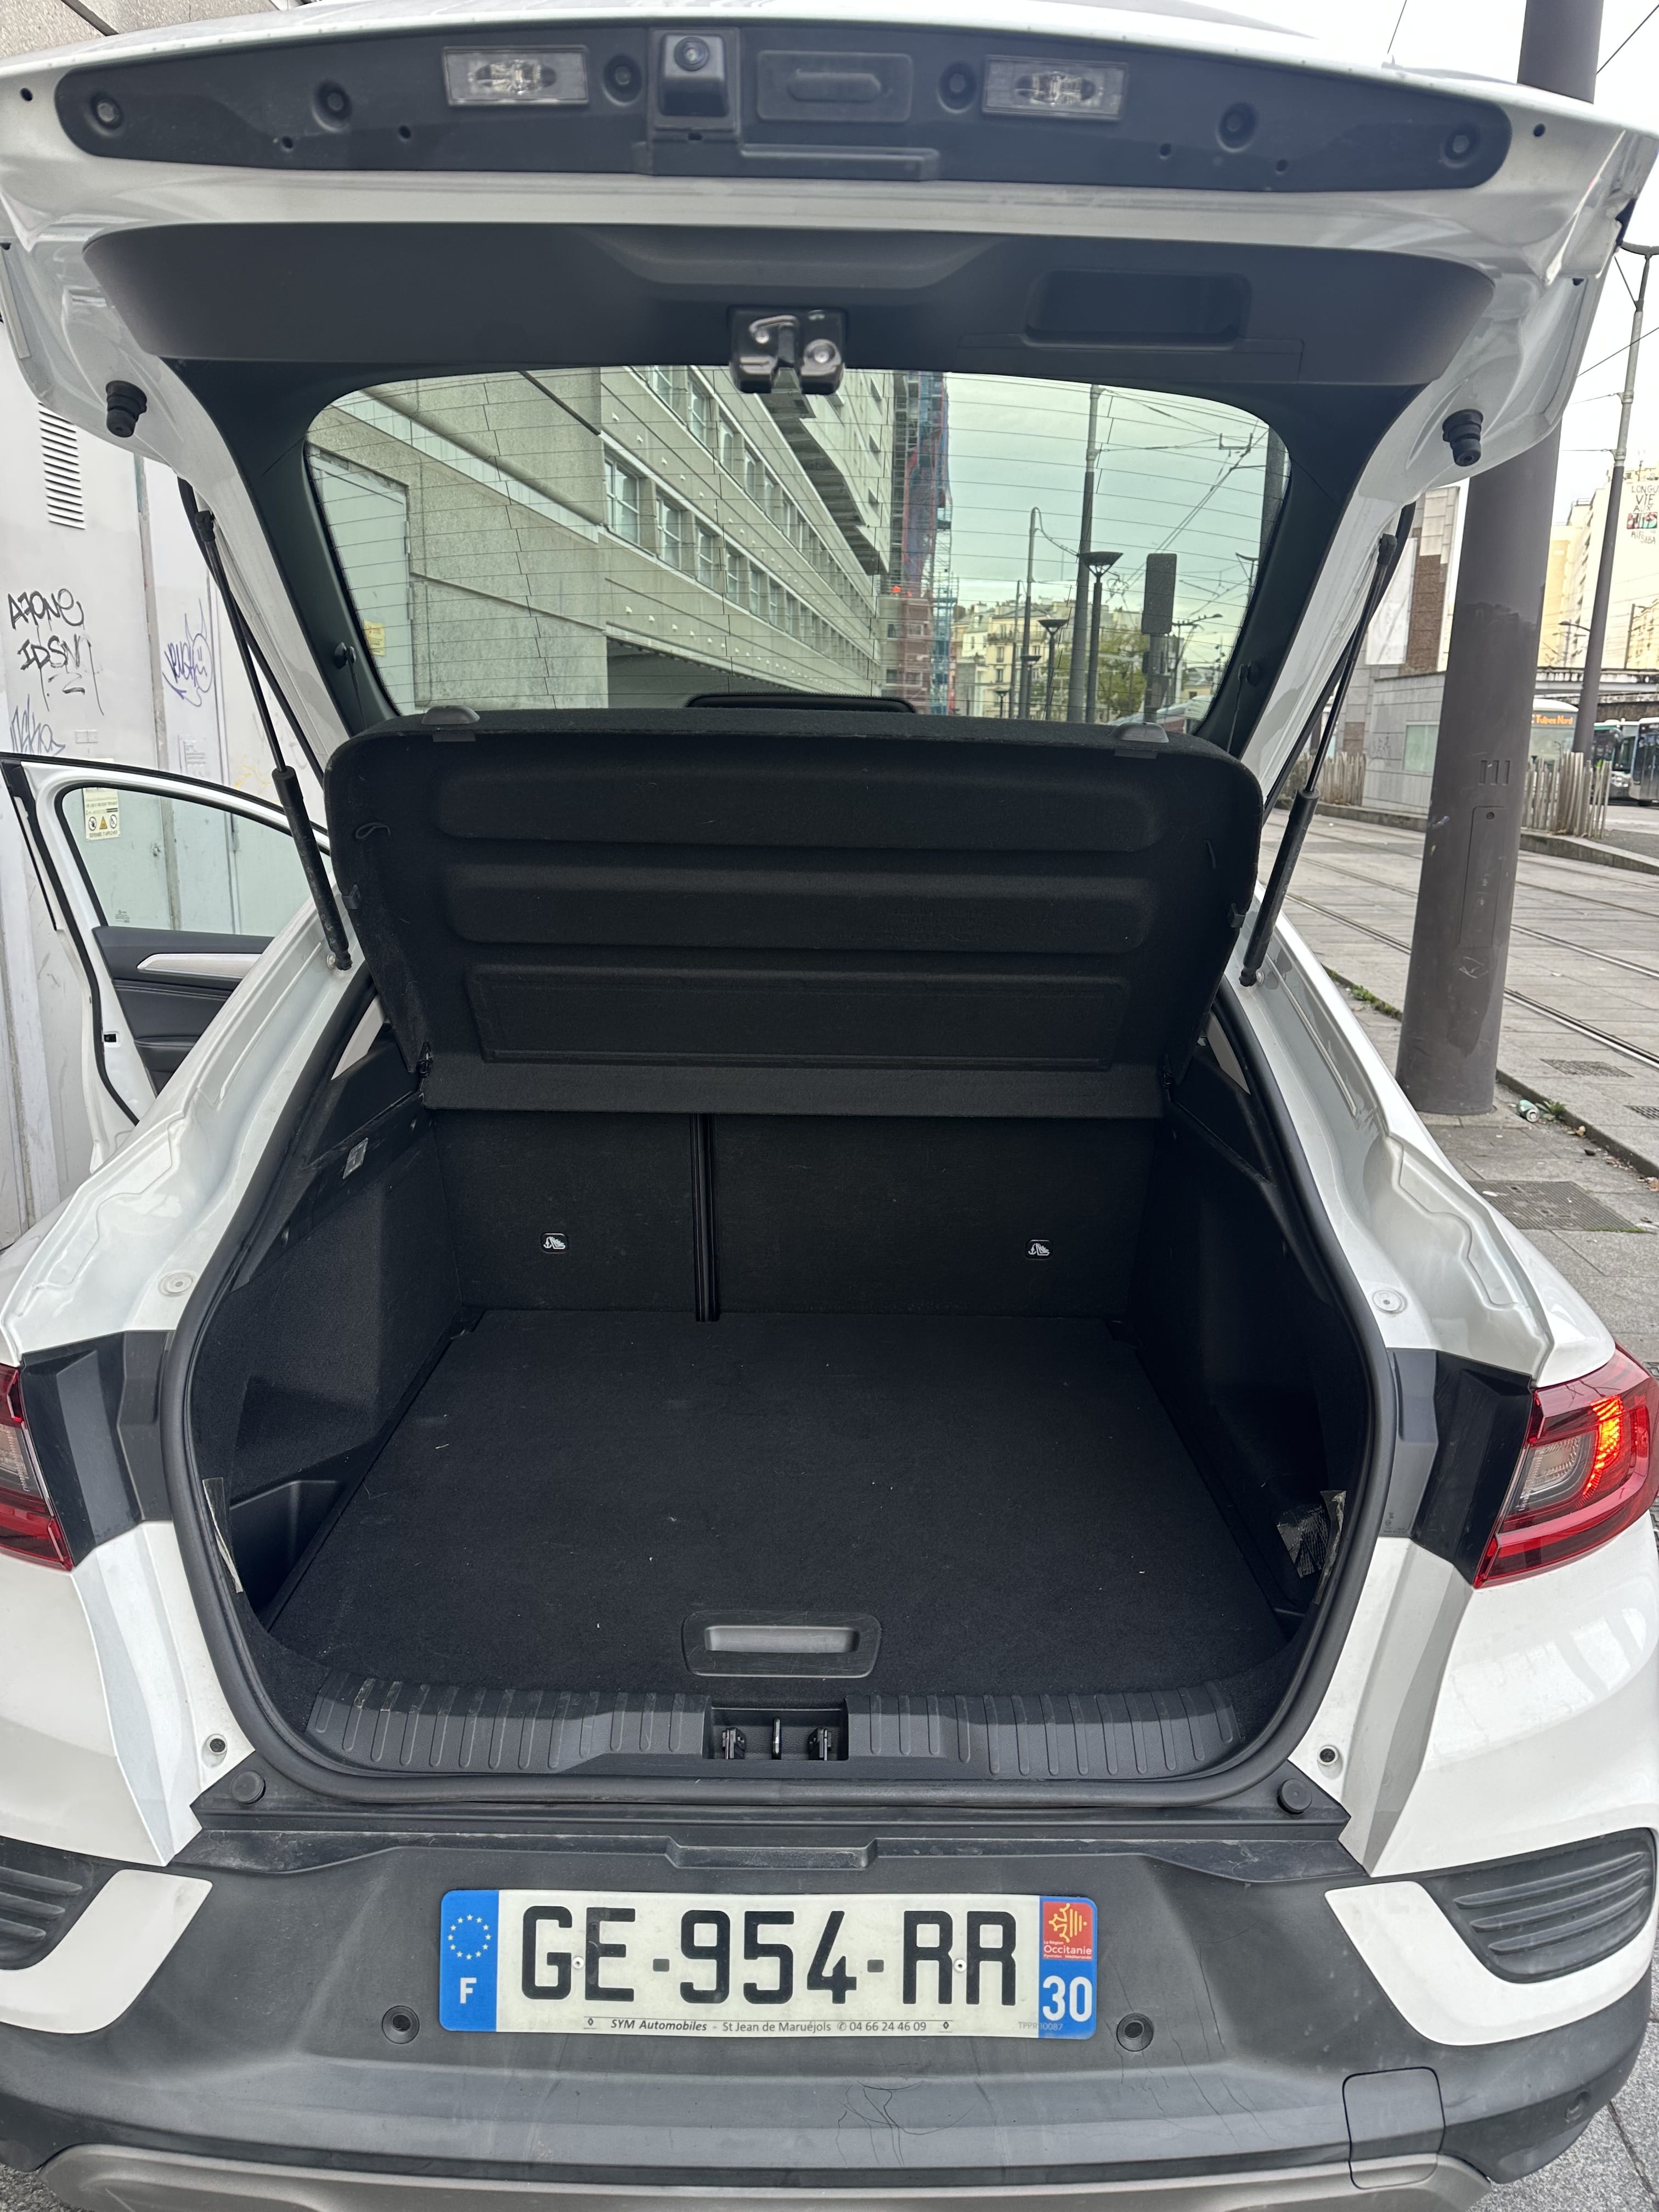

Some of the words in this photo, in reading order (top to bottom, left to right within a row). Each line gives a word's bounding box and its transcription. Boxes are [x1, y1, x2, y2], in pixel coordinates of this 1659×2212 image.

[1631, 485, 1659, 493] LONGU
[1636, 494, 1655, 505] VIE
[522, 1905, 1016, 2006] GE-954-RR
[1044, 1945, 1092, 1955] Occitanie
[460, 1977, 477, 2004] F
[1043, 1975, 1092, 2022] 30
[611, 2019, 635, 2029] SYM
[639, 2020, 707, 2031] Automobiles
[723, 2022, 733, 2032] St
[736, 2022, 759, 2032] Jean
[763, 2021, 775, 2032] de
[779, 2021, 831, 2034] Maruéjols
[850, 2022, 862, 2031] 04
[866, 2022, 878, 2031] 66
[882, 2022, 894, 2031] 24
[898, 2022, 911, 2031] 46
[913, 2021, 927, 2031] 09
